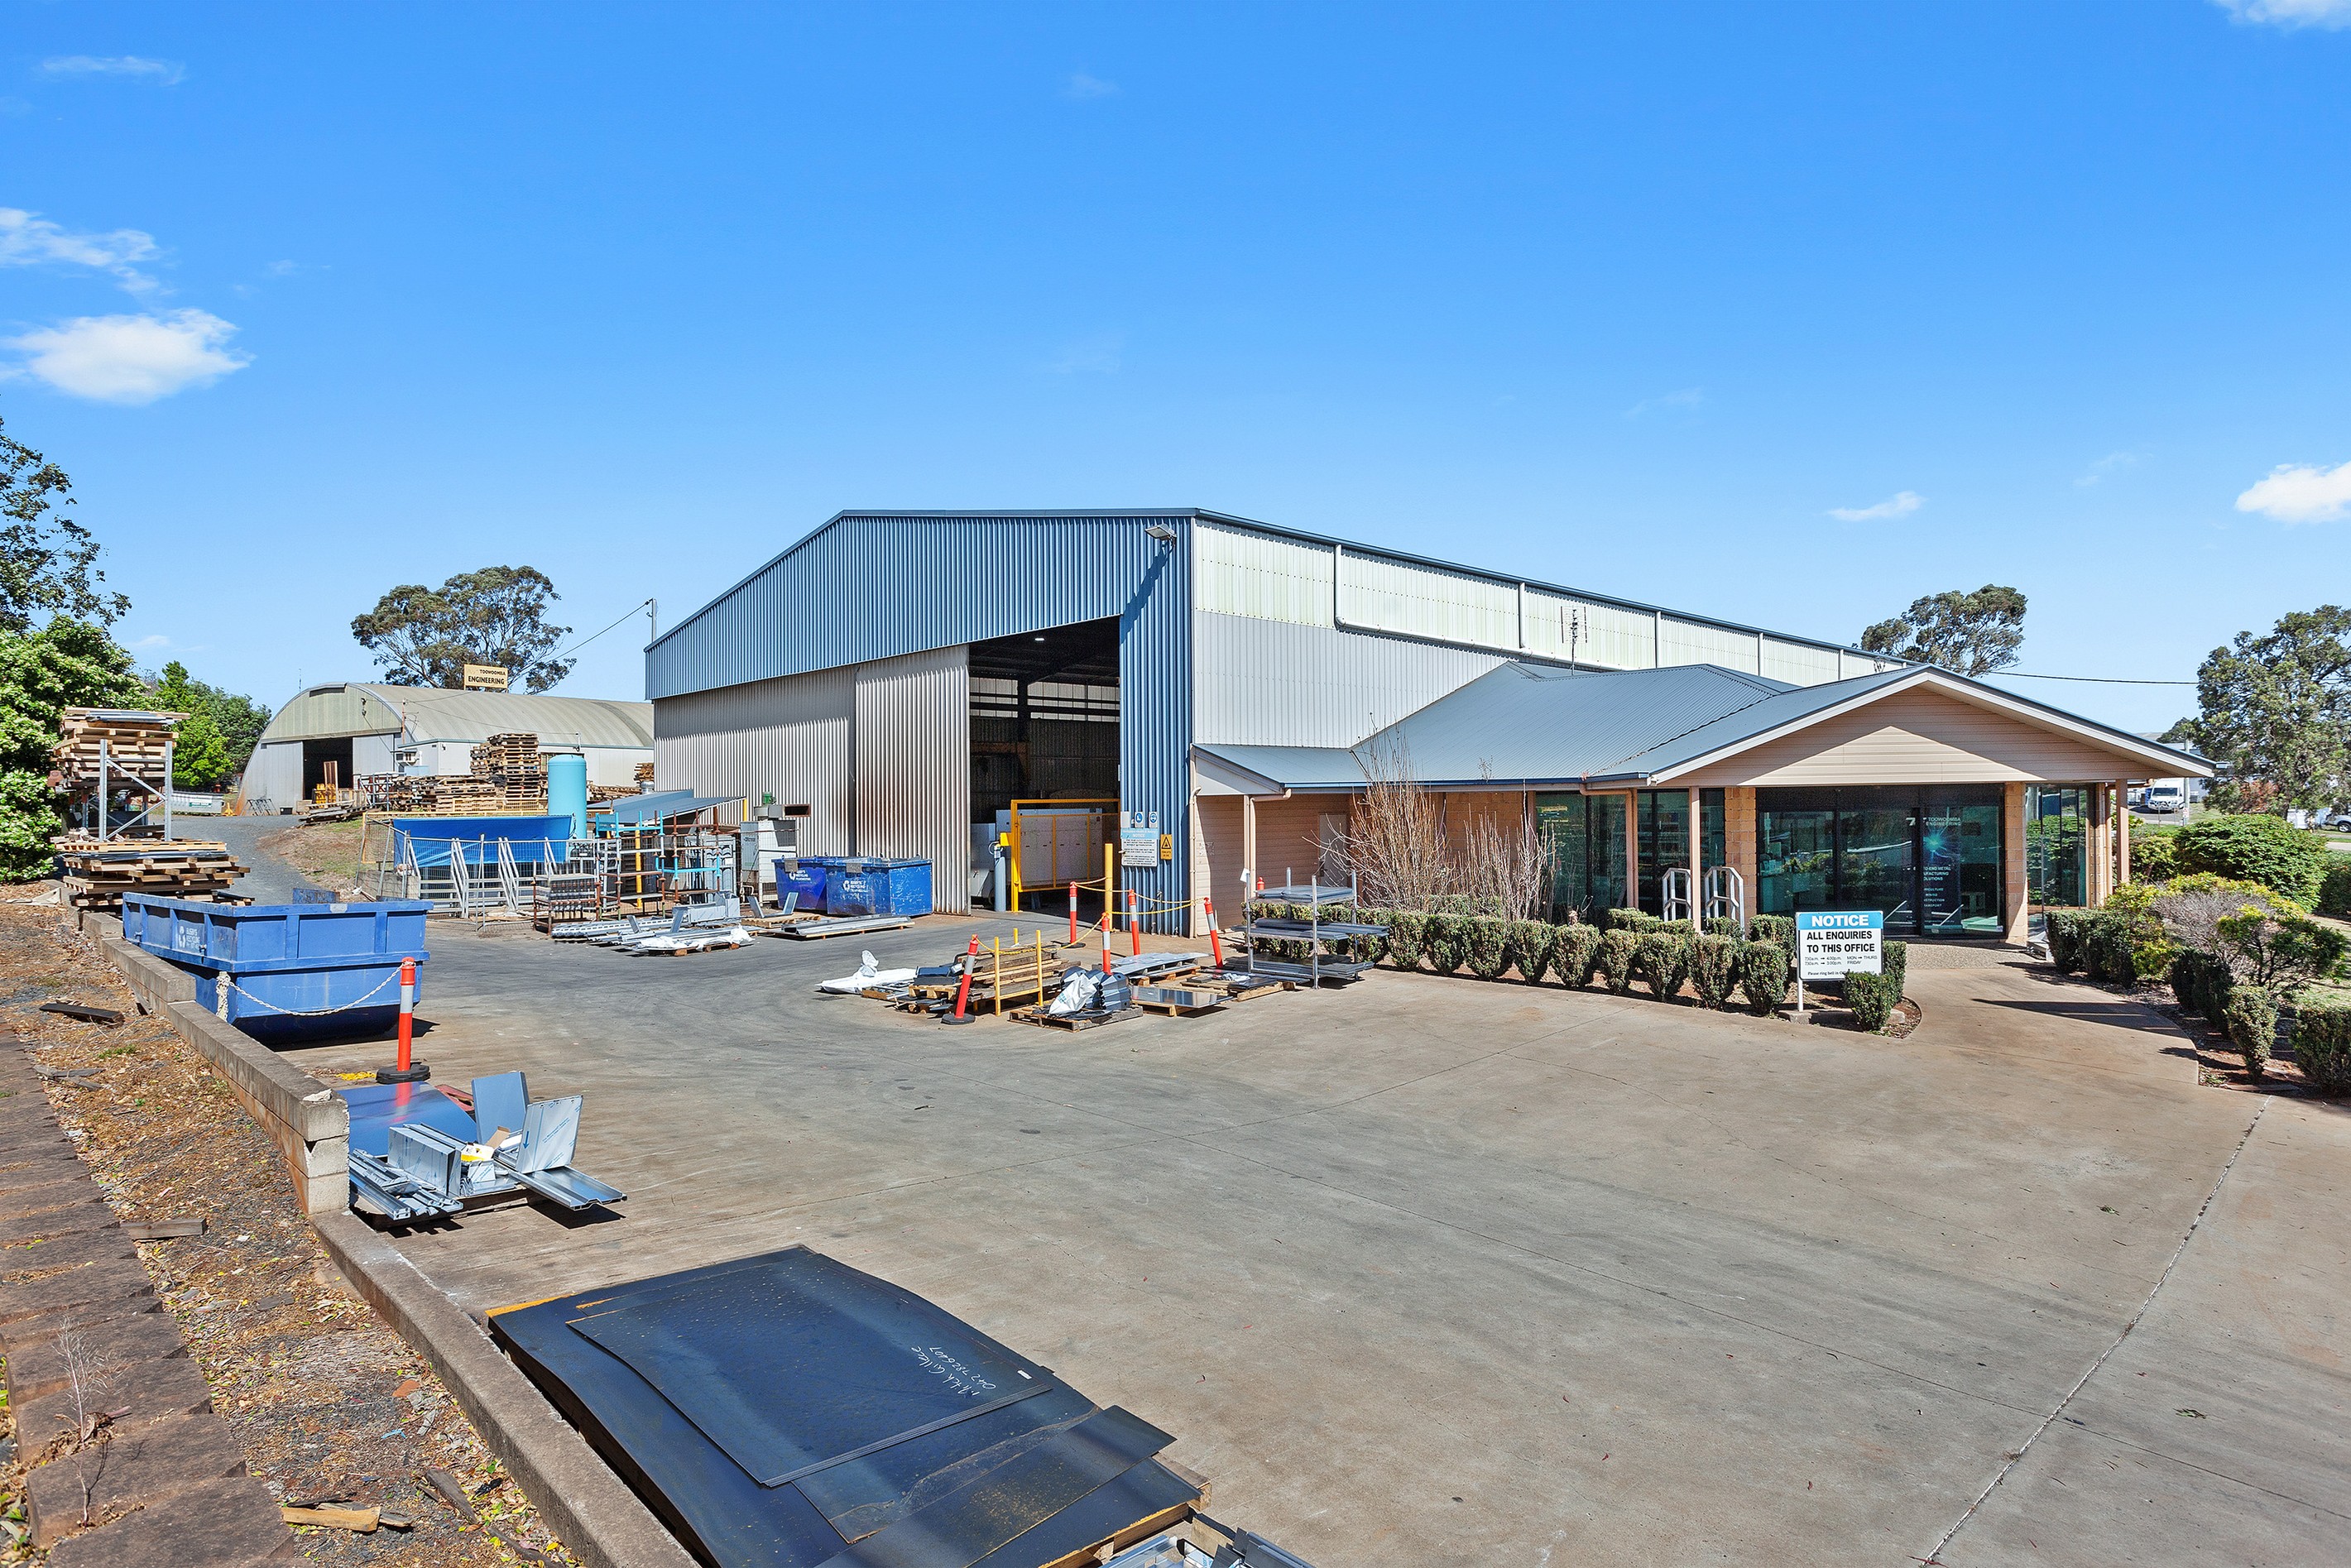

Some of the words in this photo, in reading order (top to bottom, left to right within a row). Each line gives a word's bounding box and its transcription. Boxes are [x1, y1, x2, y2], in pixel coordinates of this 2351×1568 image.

[468, 676, 505, 684] ENGINEERING
[1811, 915, 1869, 927] NOTICE
[1807, 932, 1823, 940] ALL
[1826, 931, 1872, 940] ENQUIRIES
[1806, 945, 1819, 953] TO
[1821, 944, 1841, 952] THIS
[1845, 943, 1875, 952] OFFICE
